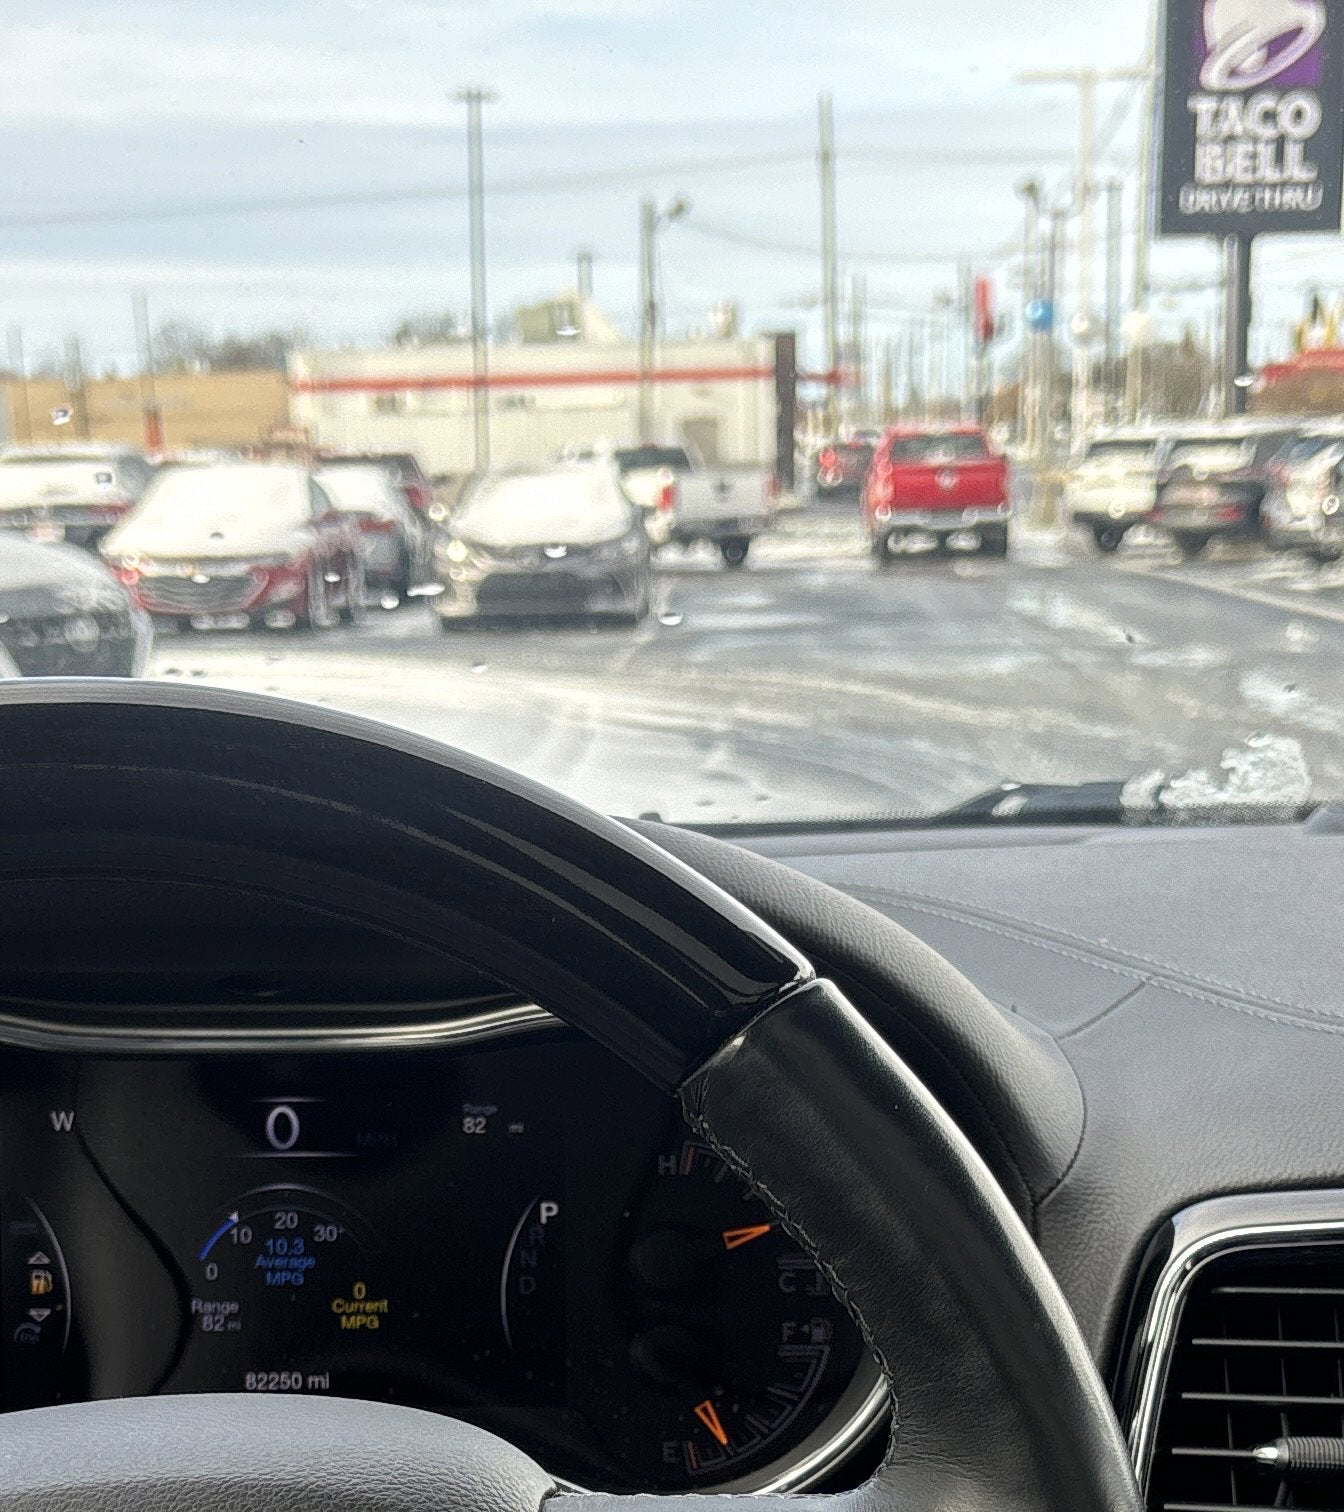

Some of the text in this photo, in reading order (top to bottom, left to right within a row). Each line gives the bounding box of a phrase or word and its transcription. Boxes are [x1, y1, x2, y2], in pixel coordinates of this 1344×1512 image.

[1186, 89, 1322, 138] TACO
[1195, 138, 1318, 183] BELL
[51, 1112, 75, 1132] W
[462, 1117, 487, 1134] 82
[658, 1155, 677, 1176] H
[274, 1211, 298, 1229] 20
[539, 1202, 559, 1224] P
[231, 1226, 253, 1244] 10
[265, 1237, 305, 1254] 10.3
[205, 1262, 218, 1280] 0
[255, 1255, 316, 1272] Average
[265, 1271, 305, 1287] MPG
[353, 1281, 367, 1299] 0
[191, 1299, 239, 1316] Range
[331, 1299, 389, 1314] Current
[202, 1316, 225, 1331] 82
[340, 1314, 380, 1330] MPG
[244, 1371, 329, 1390] 82250 mi
